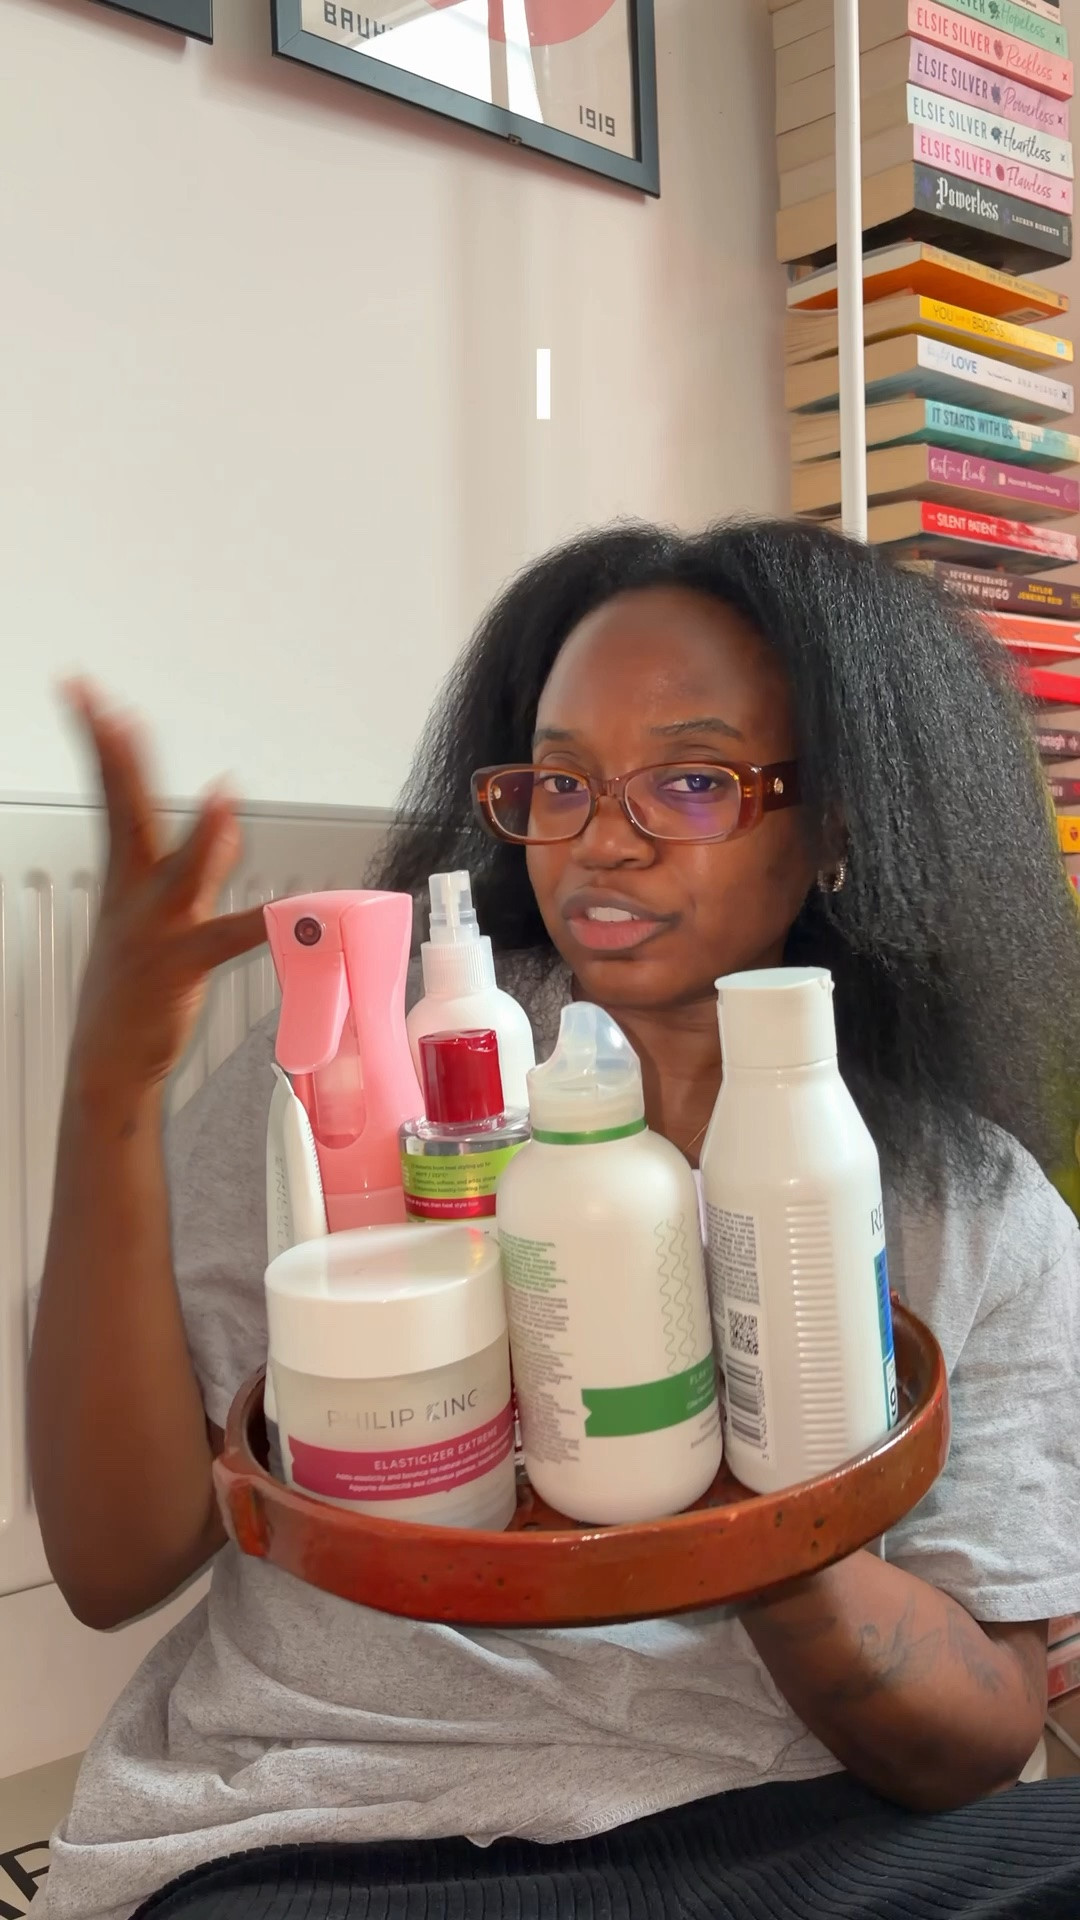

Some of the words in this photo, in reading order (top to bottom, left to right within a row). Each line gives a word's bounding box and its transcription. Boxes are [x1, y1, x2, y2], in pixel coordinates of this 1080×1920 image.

[1001, 6, 1046, 39] Hopeless
[916, 7, 949, 37] ELSIE
[952, 22, 990, 55] SILVER
[1005, 44, 1053, 81] Reckless
[916, 53, 948, 83] ELSIE
[951, 67, 988, 99] SILVER
[1004, 87, 1054, 125] Powerless
[579, 104, 616, 137] 1919
[913, 97, 946, 124] ELSIE
[949, 110, 987, 139] SILVER
[1003, 127, 1051, 162] Heartless
[920, 135, 951, 163] ELSIE
[954, 148, 992, 178] SILVER
[1006, 166, 1052, 199] Flawless
[936, 176, 999, 221] Powerless
[932, 304, 954, 322] YOU
[971, 316, 1005, 338] BADASS
[951, 353, 977, 375] LOVE
[931, 407, 942, 423] IT
[943, 409, 975, 432] STARTS
[977, 417, 1000, 437] WITH
[1001, 423, 1014, 440] US
[937, 512, 967, 532] SILENT
[968, 519, 998, 536] PATIENT
[949, 570, 972, 581] SEVEN
[981, 585, 1010, 601] HUGO
[326, 1407, 415, 1431] PHILIP
[373, 1447, 455, 1472] ELASTICIZER
[457, 1425, 498, 1455] EXTREME
